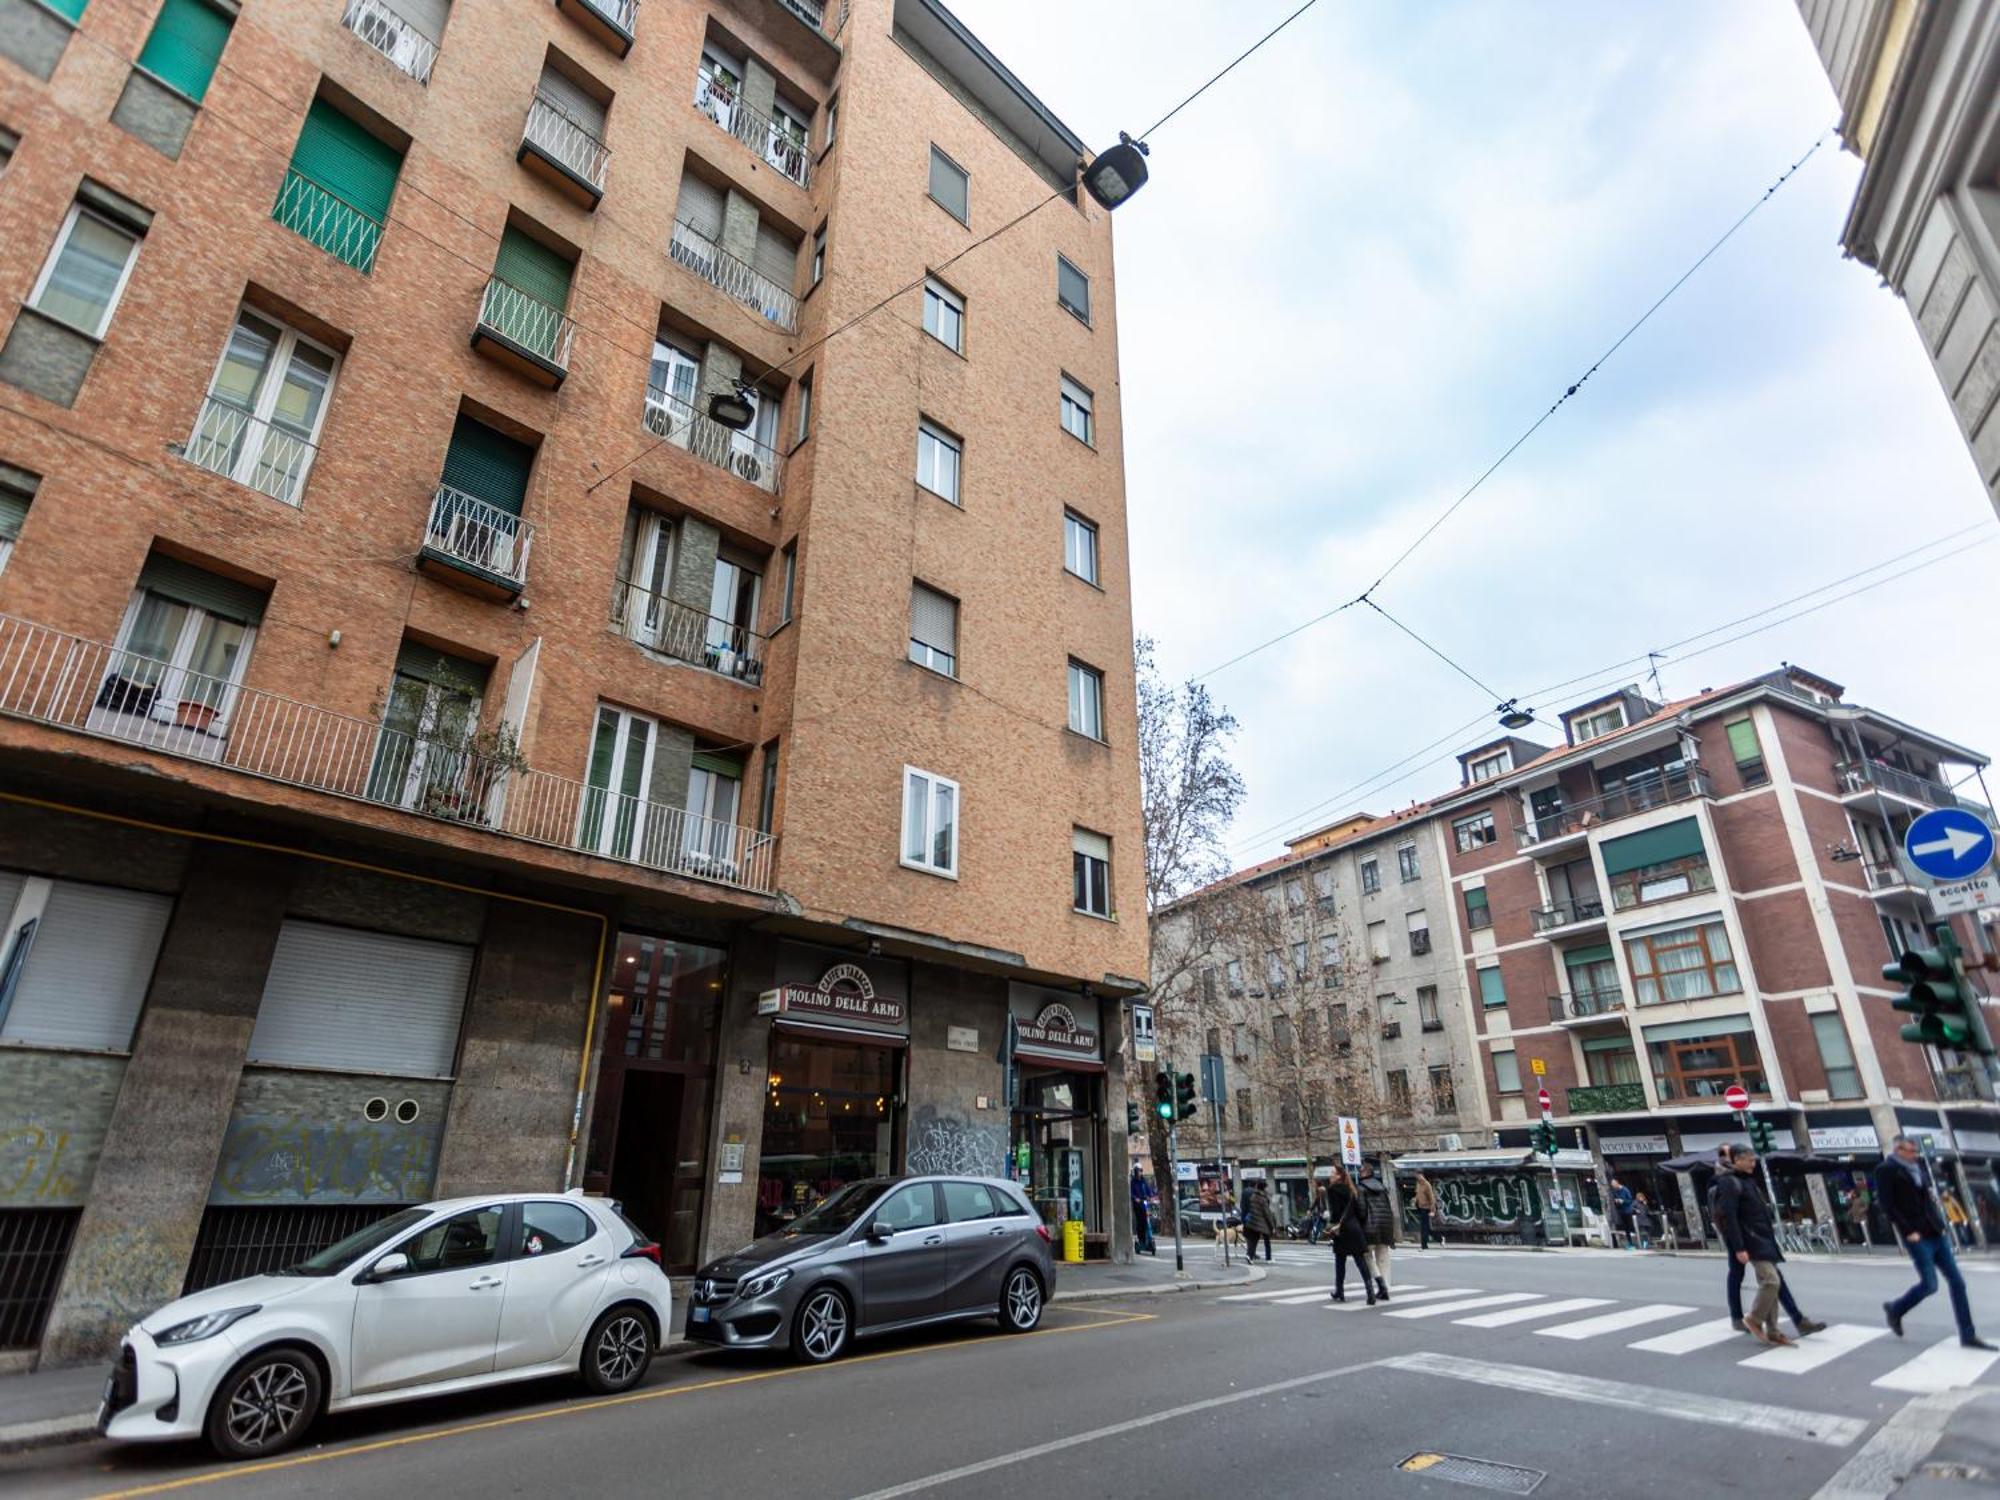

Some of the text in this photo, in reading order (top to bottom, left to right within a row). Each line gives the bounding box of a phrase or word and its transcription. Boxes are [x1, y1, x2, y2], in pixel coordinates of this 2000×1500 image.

[1939, 879, 1988, 897] eccetto
[787, 989, 831, 1007] MOLINO
[835, 996, 869, 1013] DELLE
[872, 1002, 900, 1018] ARMI
[1048, 1030, 1072, 1044] DELLE
[1074, 1035, 1095, 1047] ARMI
[1814, 1136, 1874, 1147] VOGUE BAR
